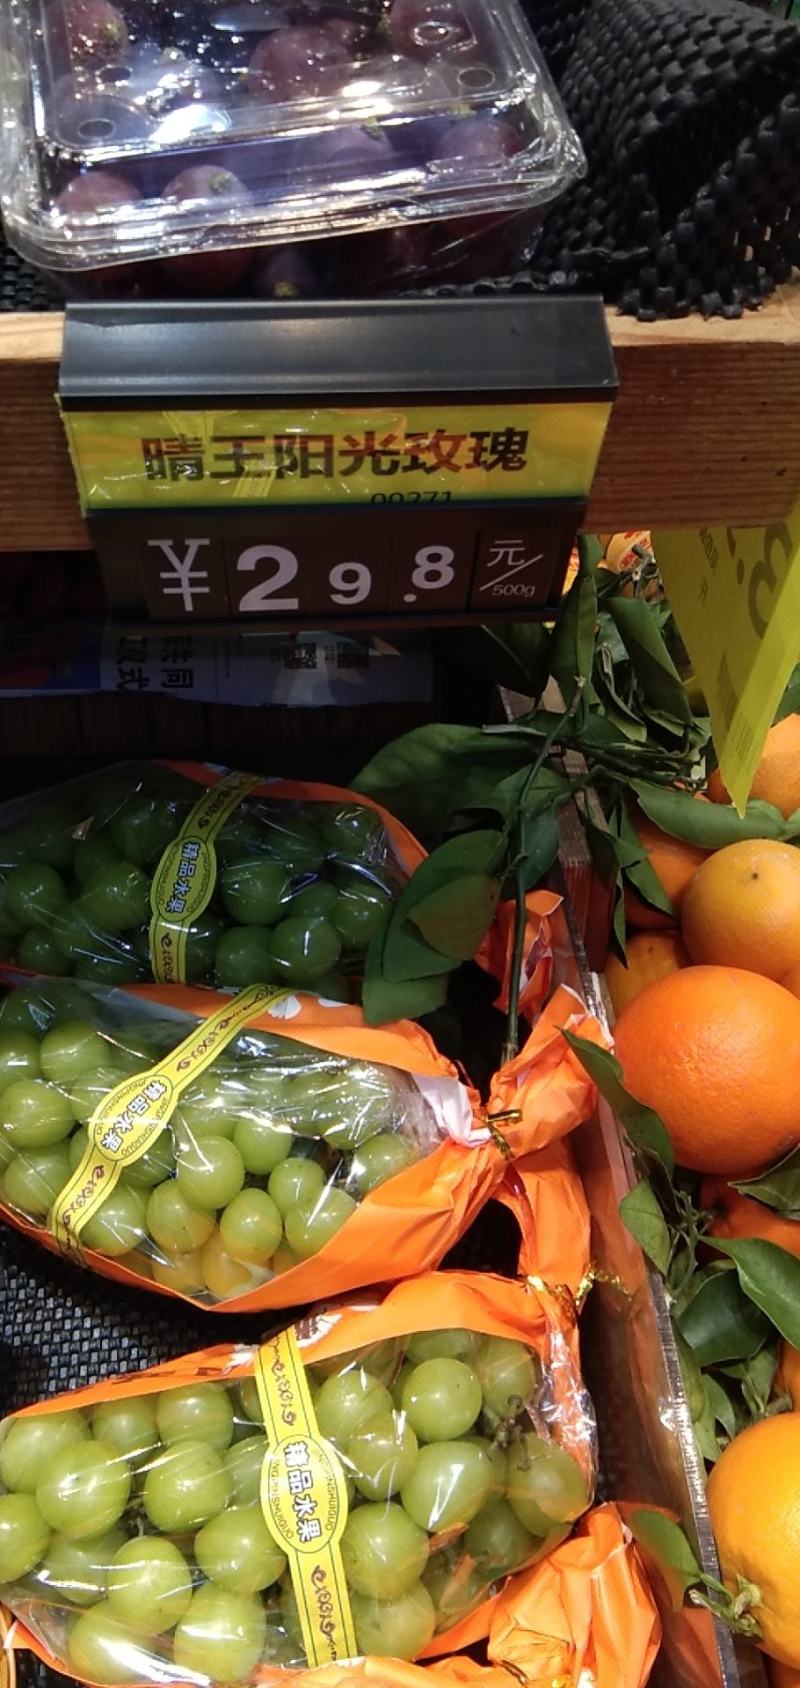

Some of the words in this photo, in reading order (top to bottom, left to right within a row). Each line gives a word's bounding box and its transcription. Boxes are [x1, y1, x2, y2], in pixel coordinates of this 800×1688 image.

[142, 427, 529, 481] 晴王阳光玫瑰
[165, 840, 201, 914] 精品水果
[101, 1080, 167, 1152] 精品水果
[284, 1441, 322, 1543] 精品水果
